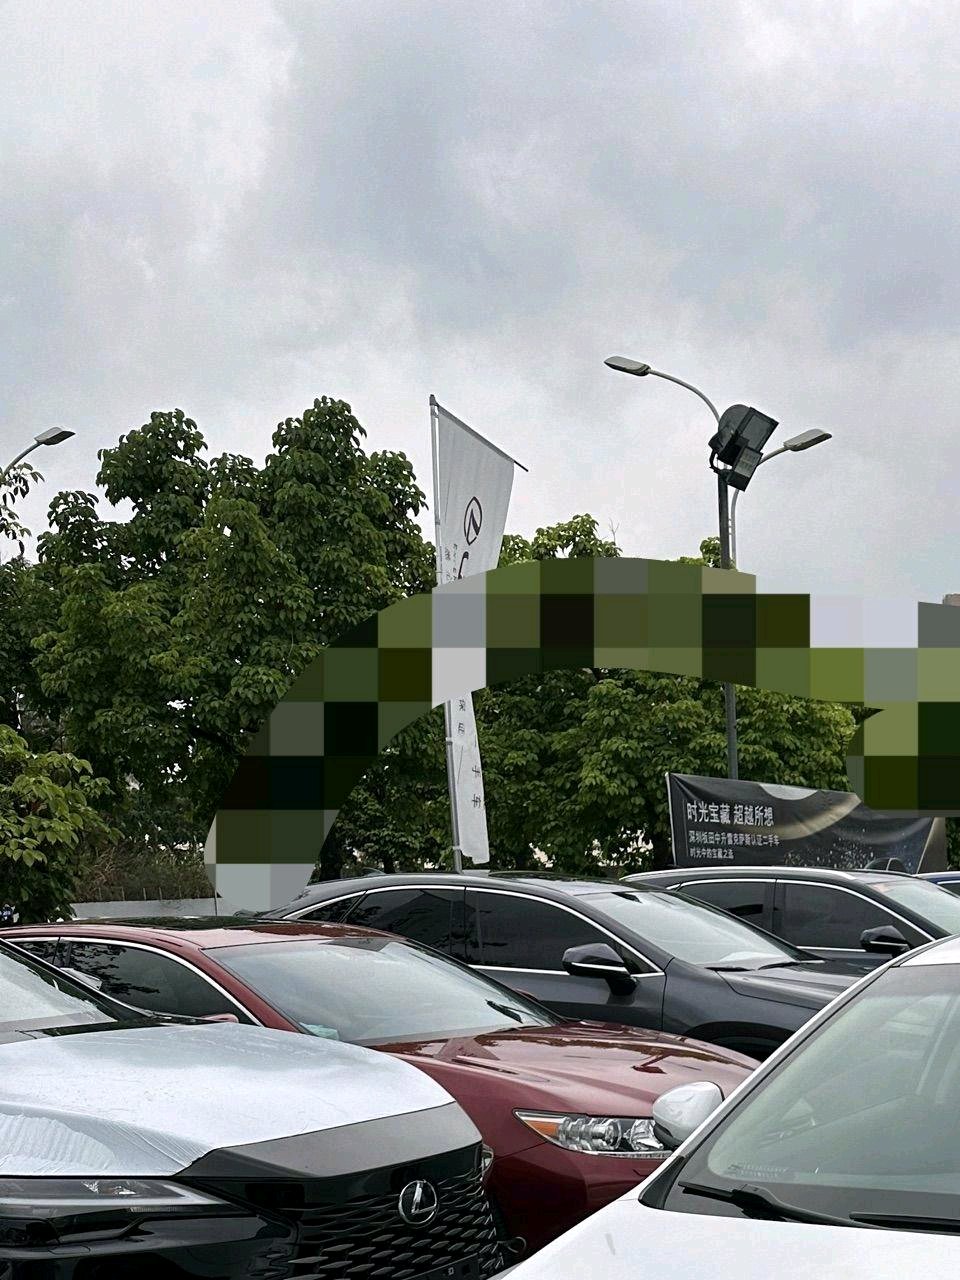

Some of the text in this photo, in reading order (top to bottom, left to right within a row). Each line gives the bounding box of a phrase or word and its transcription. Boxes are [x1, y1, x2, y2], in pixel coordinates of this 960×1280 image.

[687, 800, 774, 827] 时光宝藏 超越所想
